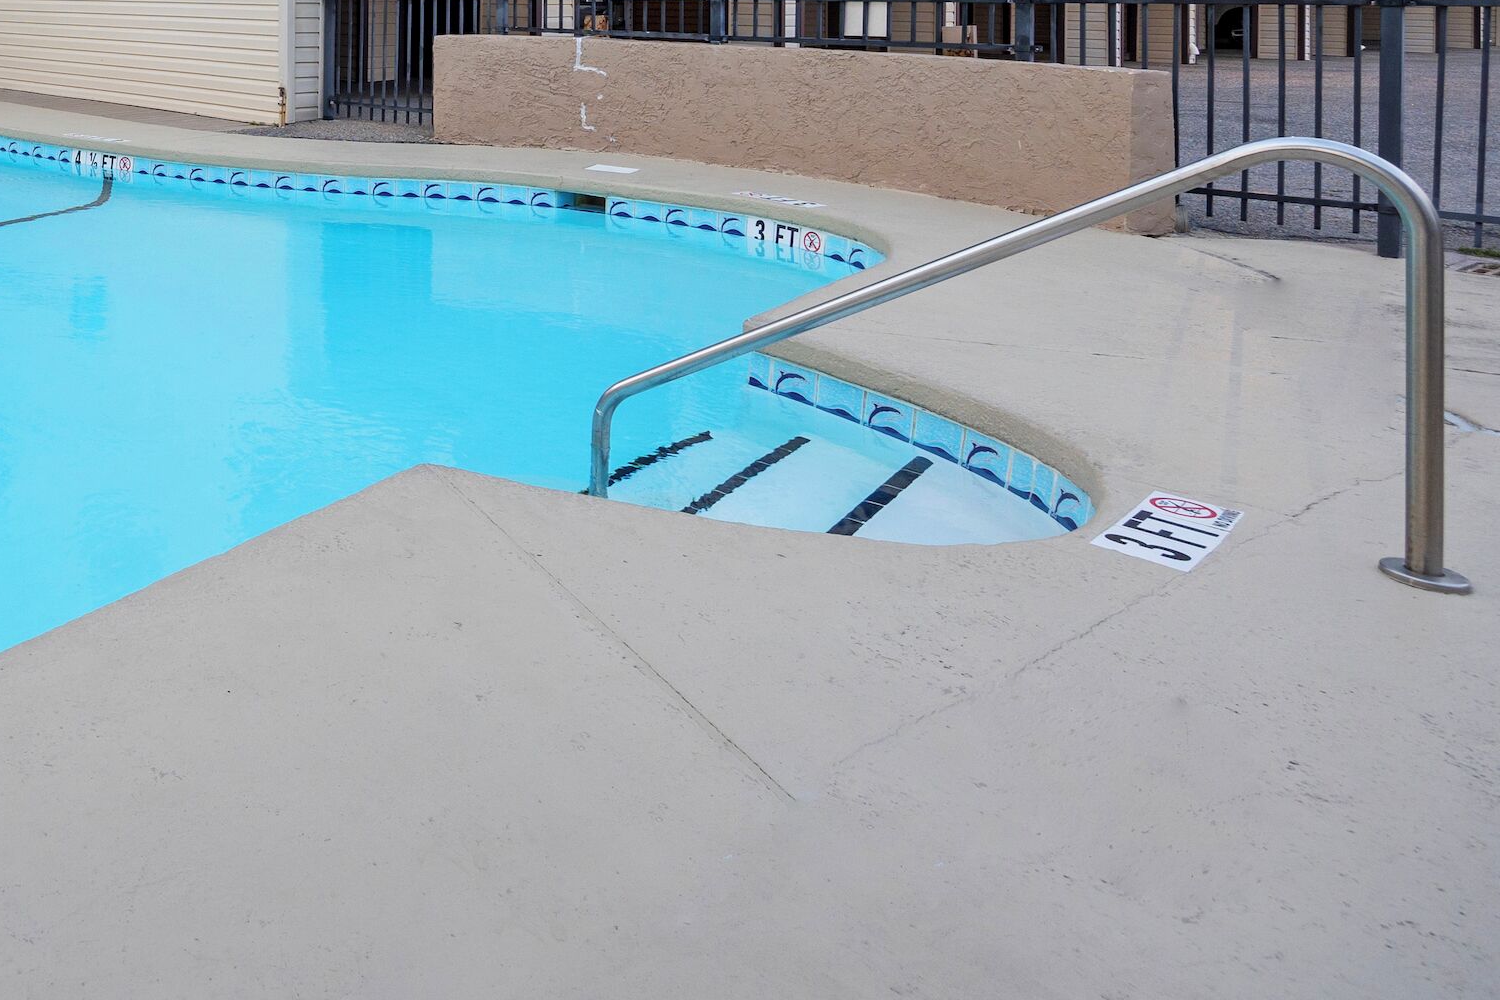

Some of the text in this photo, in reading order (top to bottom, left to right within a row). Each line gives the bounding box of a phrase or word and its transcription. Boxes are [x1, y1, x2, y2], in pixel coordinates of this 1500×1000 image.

[75, 150, 81, 164] 4
[102, 154, 116, 169] FT
[754, 220, 799, 247] 3 FT
[1104, 509, 1220, 562] 3 FT
